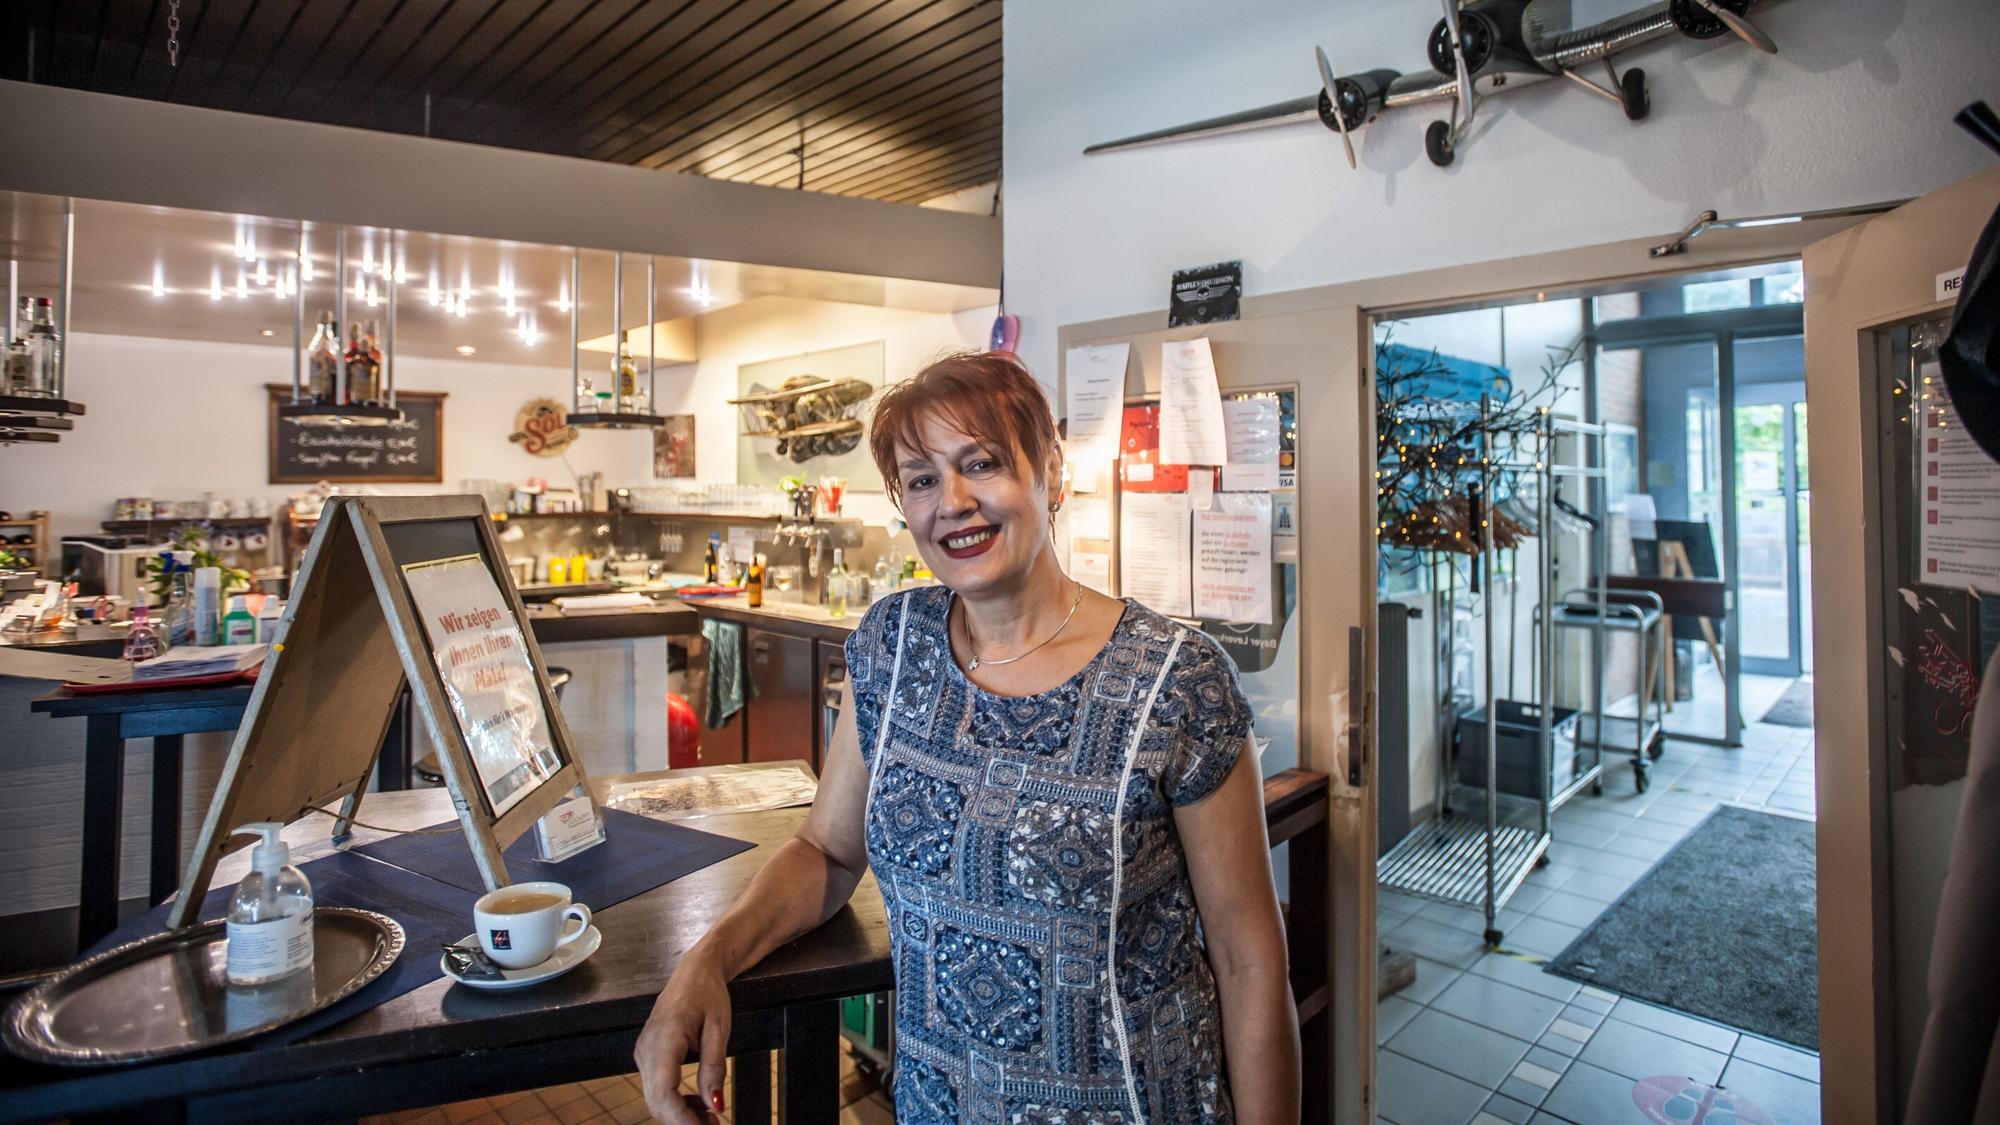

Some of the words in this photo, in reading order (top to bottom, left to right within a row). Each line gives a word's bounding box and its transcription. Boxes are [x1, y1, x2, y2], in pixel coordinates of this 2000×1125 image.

[439, 611, 464, 634] Wir
[465, 607, 501, 629] zeigen
[450, 642, 486, 667] Ihnen
[484, 634, 514, 656] Ihren
